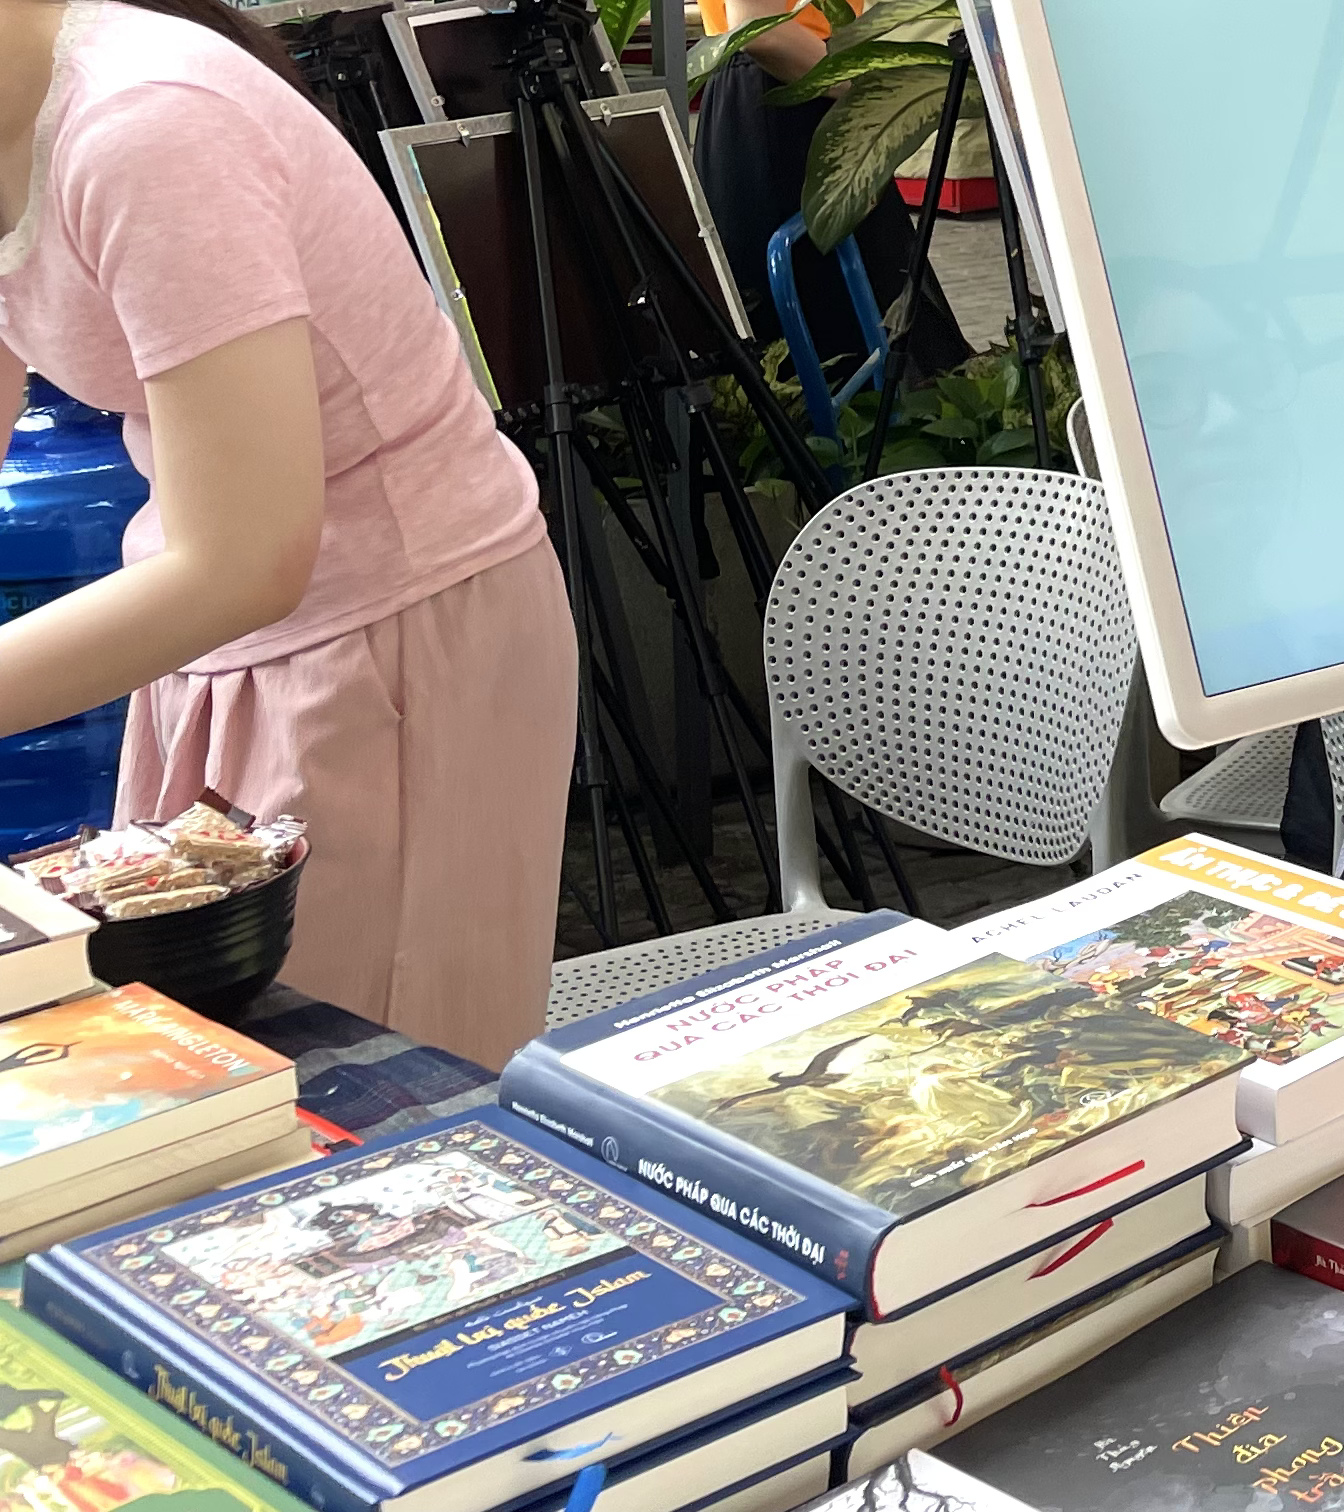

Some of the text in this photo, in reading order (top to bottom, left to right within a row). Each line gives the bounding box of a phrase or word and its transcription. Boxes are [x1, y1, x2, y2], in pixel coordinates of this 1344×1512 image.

[638, 1158, 673, 1189] NƯỚC
[675, 1176, 709, 1205] PHÁP
[710, 1192, 737, 1220] QUA
[740, 1207, 769, 1235] CÁC
[801, 1239, 825, 1265] ĐẠI
